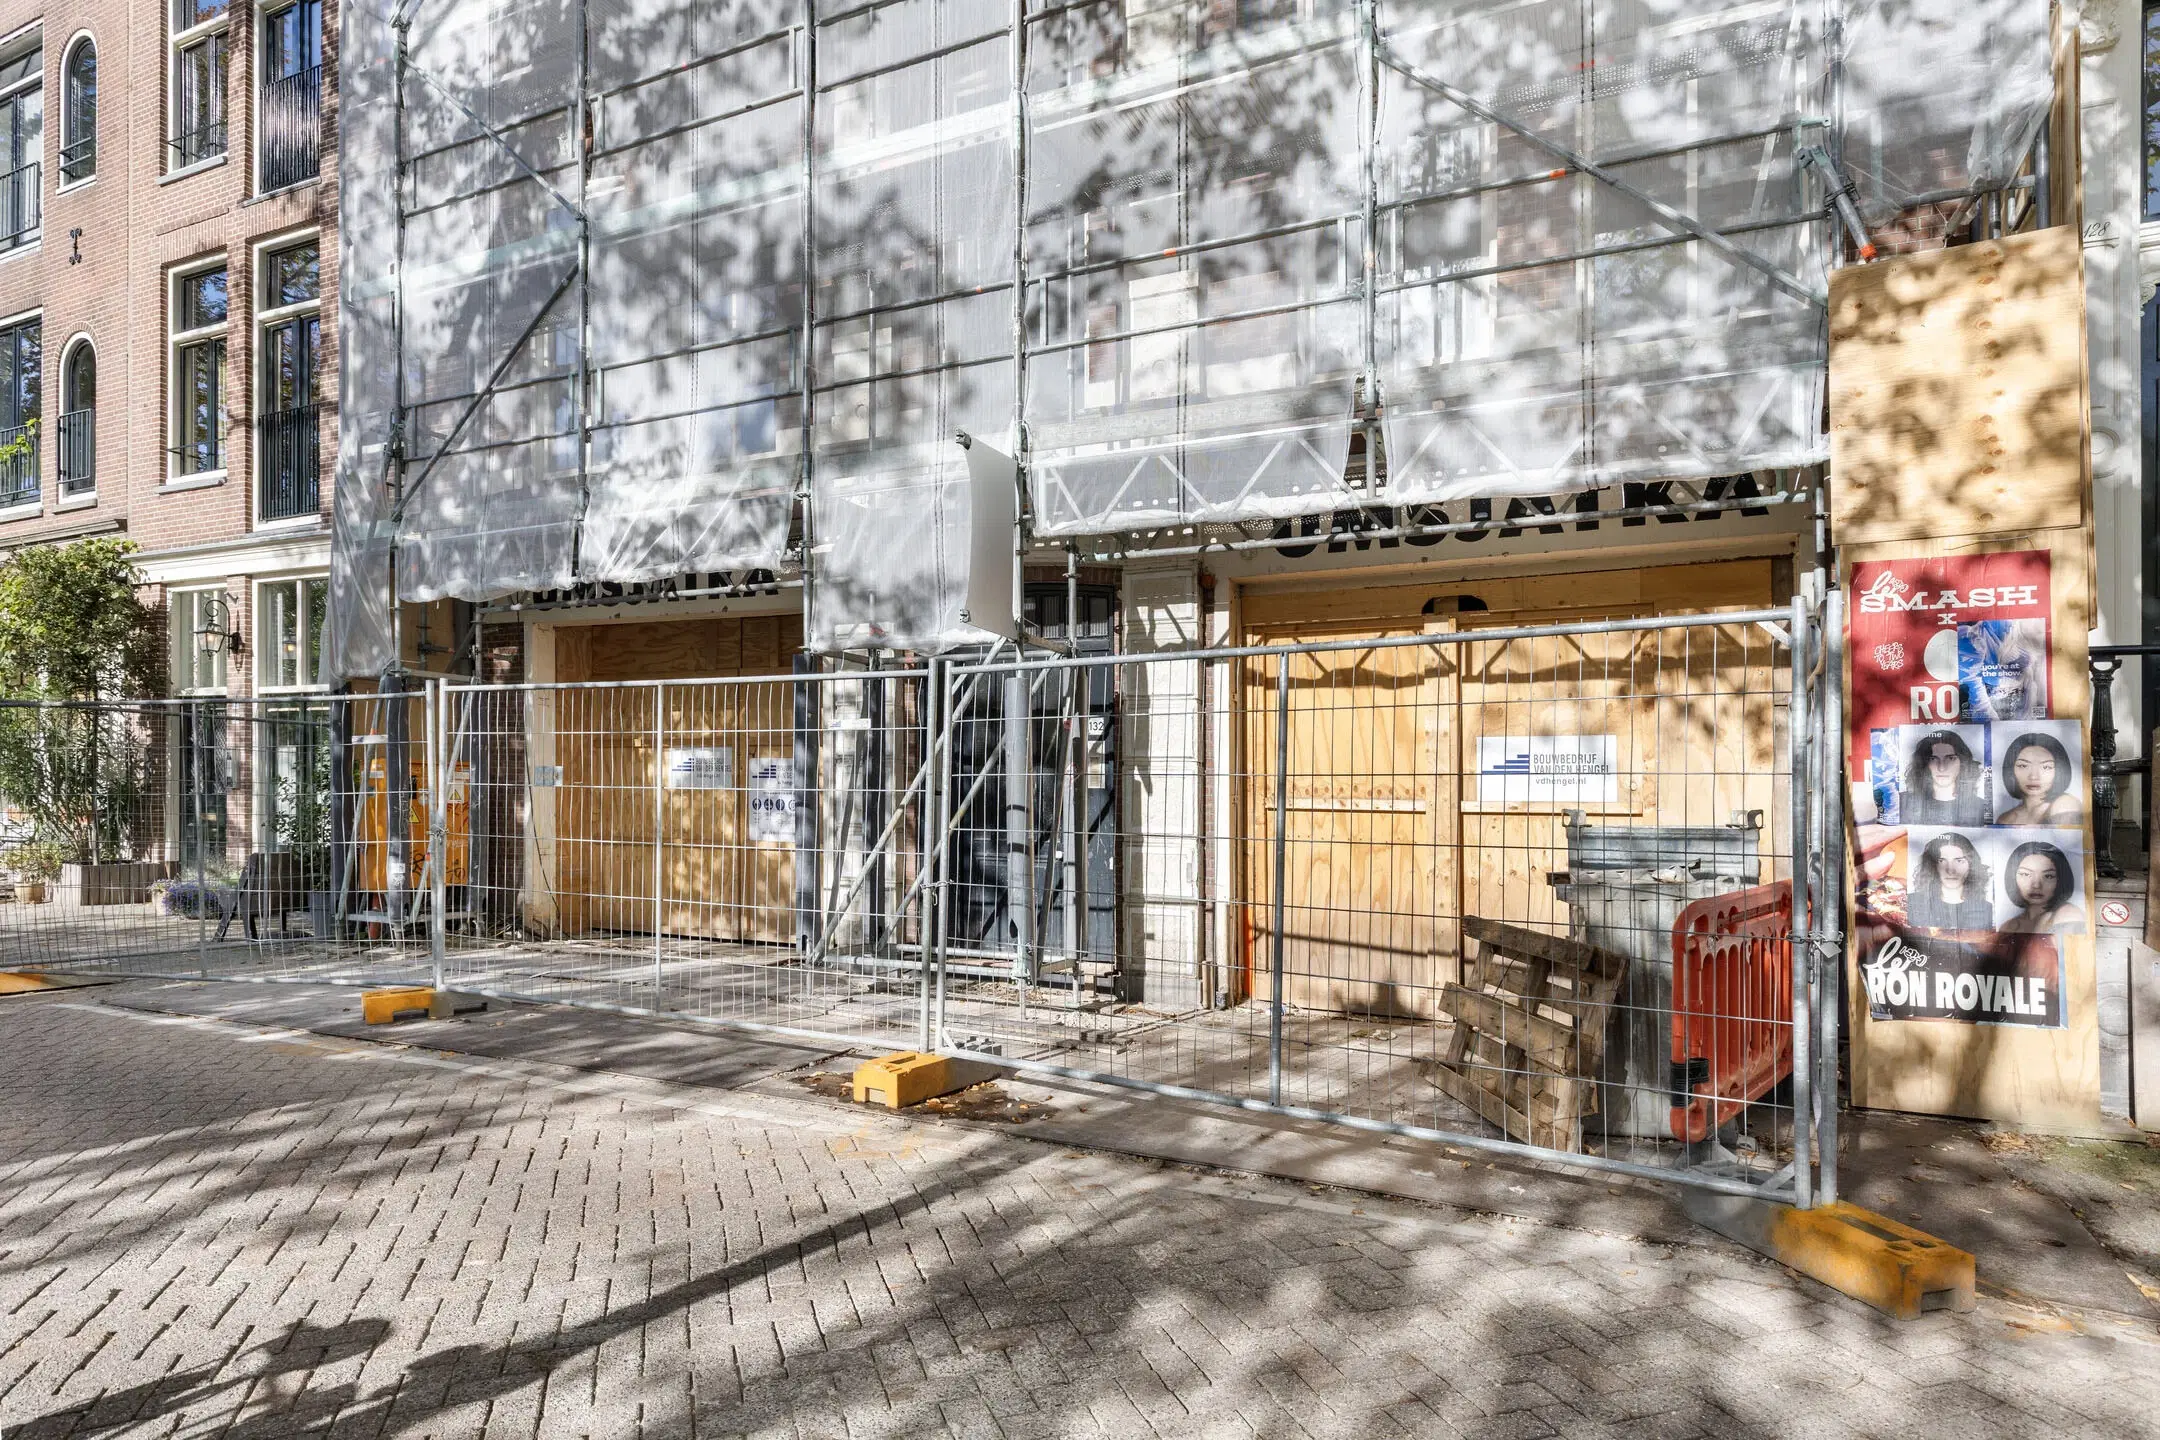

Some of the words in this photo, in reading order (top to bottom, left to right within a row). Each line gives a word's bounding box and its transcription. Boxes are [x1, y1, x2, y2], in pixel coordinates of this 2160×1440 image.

[2083, 221, 2111, 238] 128
[1860, 585, 2038, 613] SMASH
[1089, 721, 1105, 731] 132
[1533, 753, 1598, 764] BOUWBEDRIJF
[1533, 764, 1552, 774] VAN
[1554, 764, 1573, 775] DEN
[1575, 764, 1612, 775] HENGEL
[1535, 777, 1587, 786] vdhengel.nl
[1867, 968, 1928, 1008] RON
[1935, 971, 2047, 1016] ROYALE
